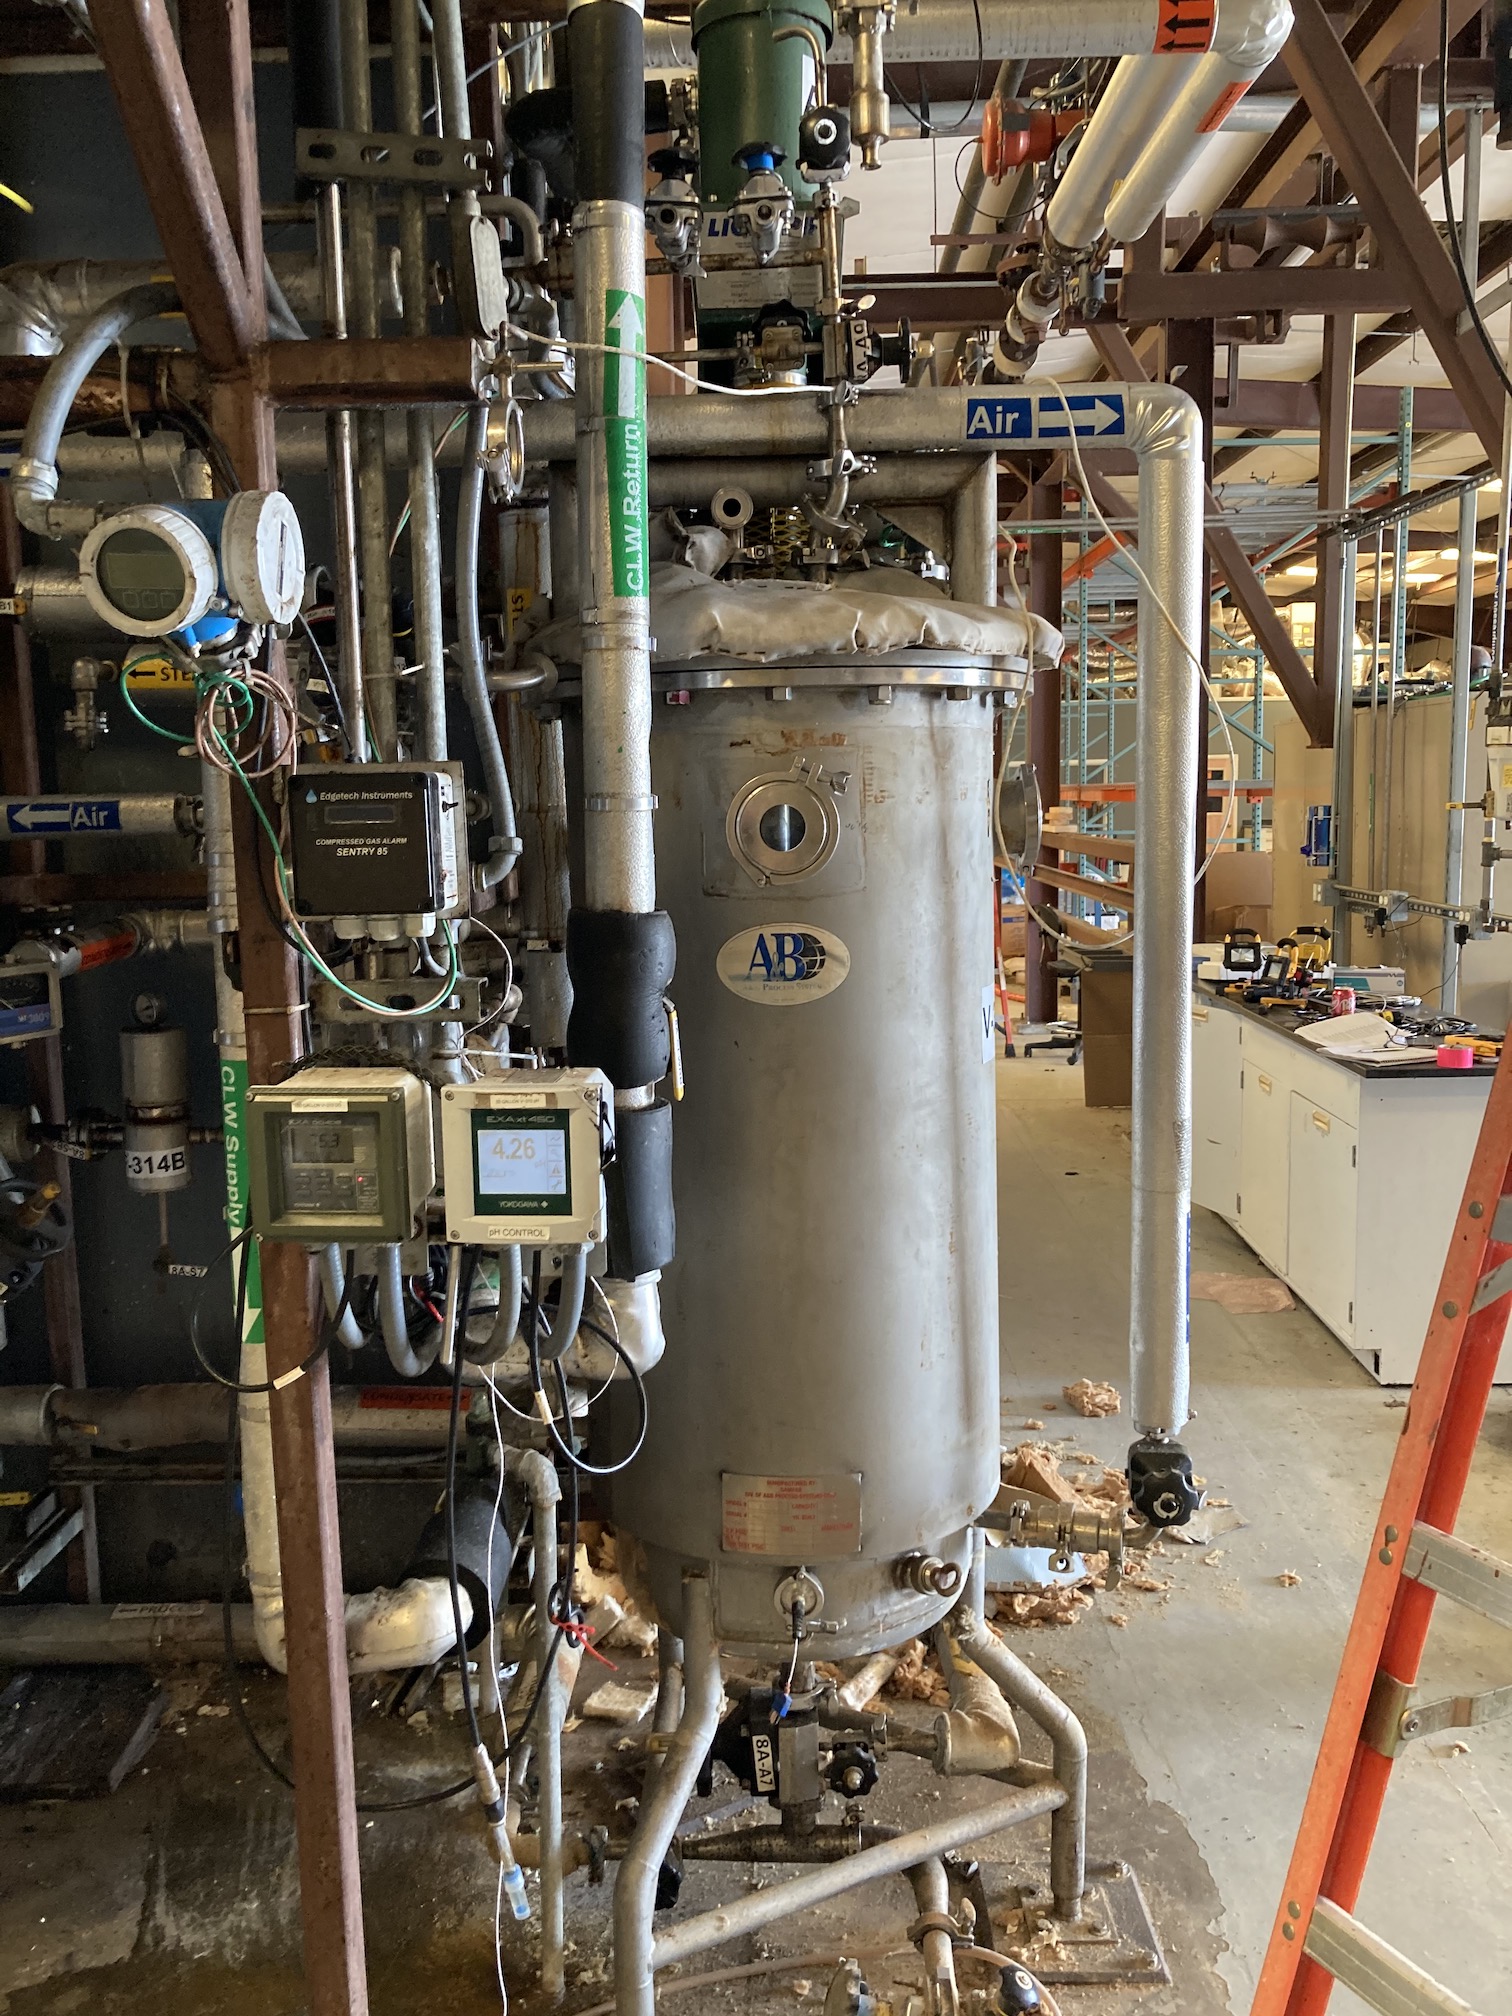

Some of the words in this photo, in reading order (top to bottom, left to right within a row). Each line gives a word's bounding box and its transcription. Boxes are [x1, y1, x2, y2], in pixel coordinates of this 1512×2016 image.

[967, 405, 1021, 436] Air
[620, 423, 643, 517] Return
[624, 524, 644, 592] CLW
[319, 791, 359, 802] Edgetech
[361, 790, 413, 800] Instruments
[73, 806, 109, 828] Air
[315, 838, 364, 846] COMPRESSED
[365, 837, 380, 845] GAS
[382, 836, 407, 845] ALARM
[336, 847, 375, 857] SENTRY
[376, 847, 389, 856] 85
[220, 1065, 238, 1129] CLW
[527, 1115, 556, 1123] 450
[491, 1137, 536, 1160] 4.26
[225, 1134, 243, 1225] Supply
[498, 1200, 538, 1208] YOKOGAWA
[489, 1229, 501, 1237] pH
[502, 1228, 546, 1237] CONTROL
[171, 1266, 203, 1277] 8A-S7
[755, 1738, 774, 1788] 8A-A7
